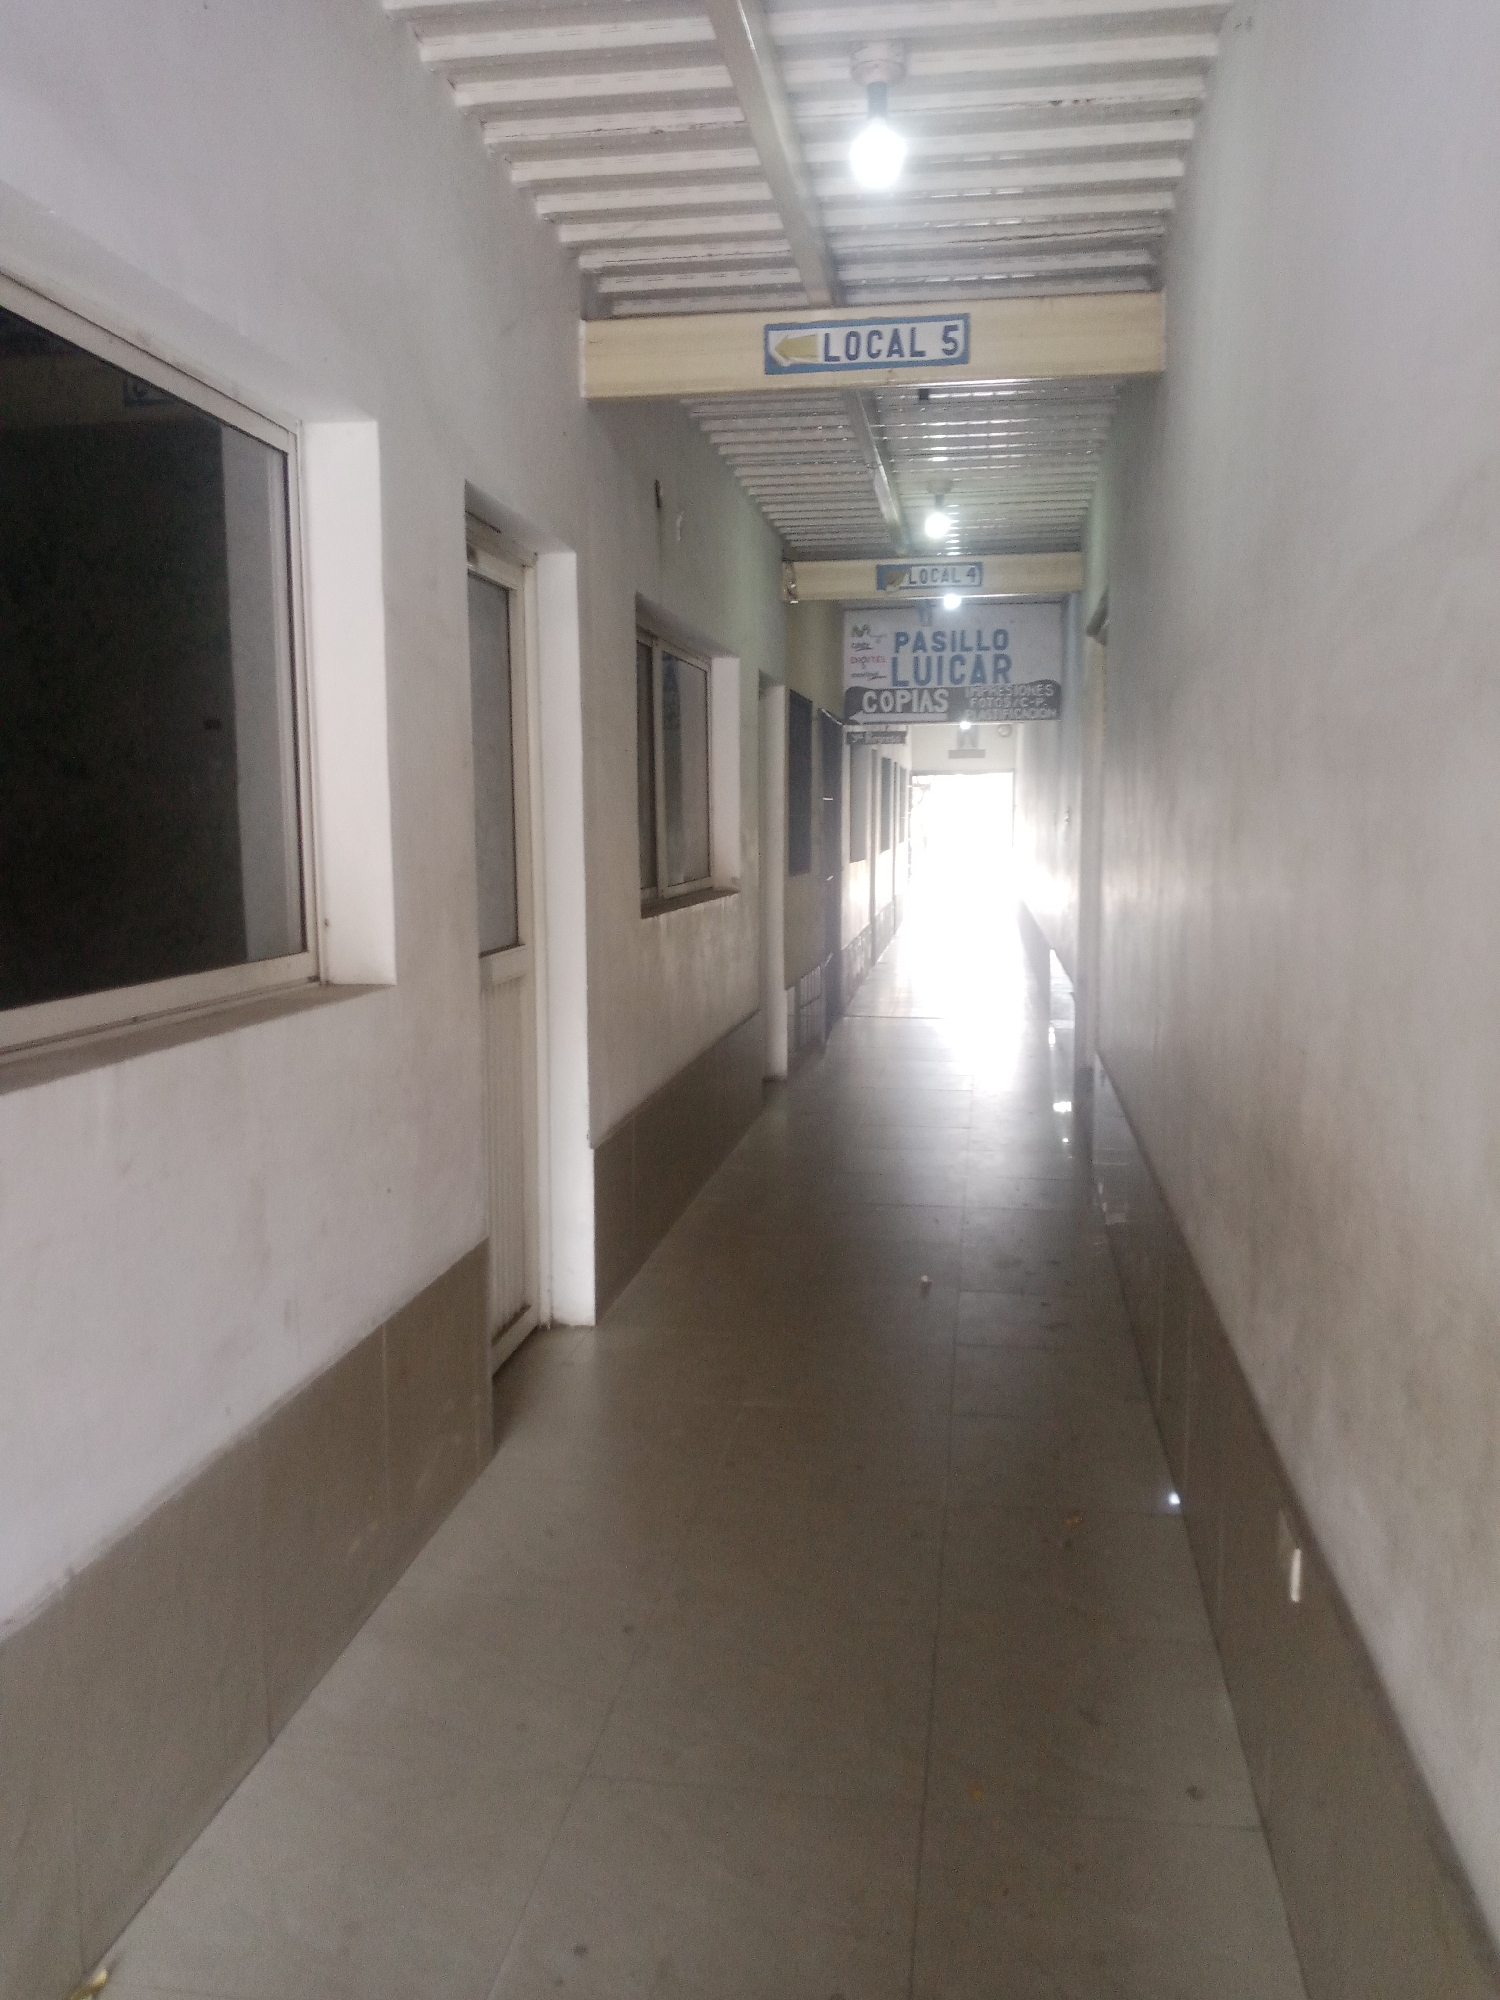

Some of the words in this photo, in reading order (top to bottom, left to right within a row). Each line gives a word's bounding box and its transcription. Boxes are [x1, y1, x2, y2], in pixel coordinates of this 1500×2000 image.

[823, 327, 926, 362] LOCAL
[942, 324, 959, 356] 5
[909, 567, 961, 584] LOCAL
[966, 566, 977, 583] 4
[894, 628, 1010, 654] PASILLO
[891, 653, 1013, 687] LUICAR
[862, 688, 949, 713] COPIAS
